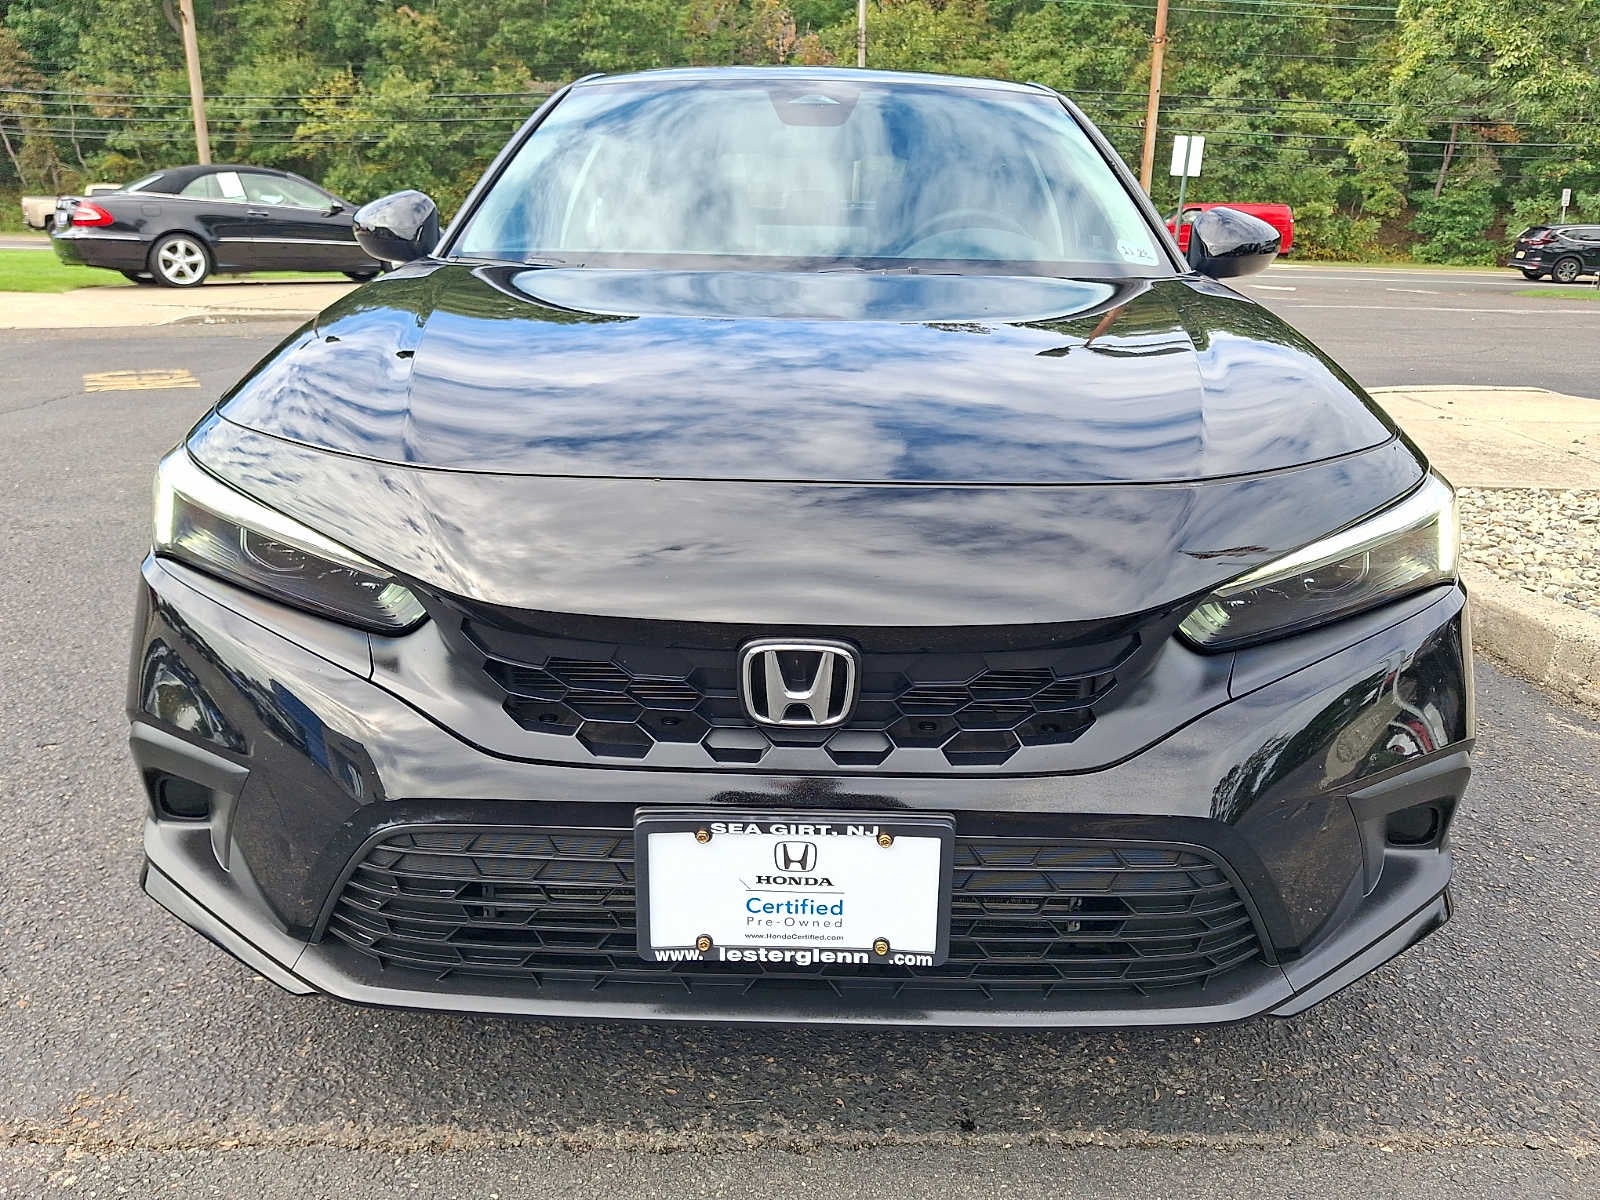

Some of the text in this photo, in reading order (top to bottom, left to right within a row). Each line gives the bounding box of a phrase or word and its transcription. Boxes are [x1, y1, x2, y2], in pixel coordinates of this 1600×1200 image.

[710, 822, 880, 837] SEA GIRT, NJ
[755, 875, 835, 887] HONDA
[746, 897, 843, 915] Certified
[746, 916, 843, 928] Pre-Owned
[744, 933, 844, 941] www.HondaCertified.com
[654, 946, 933, 967] www. lesterglenn .com
